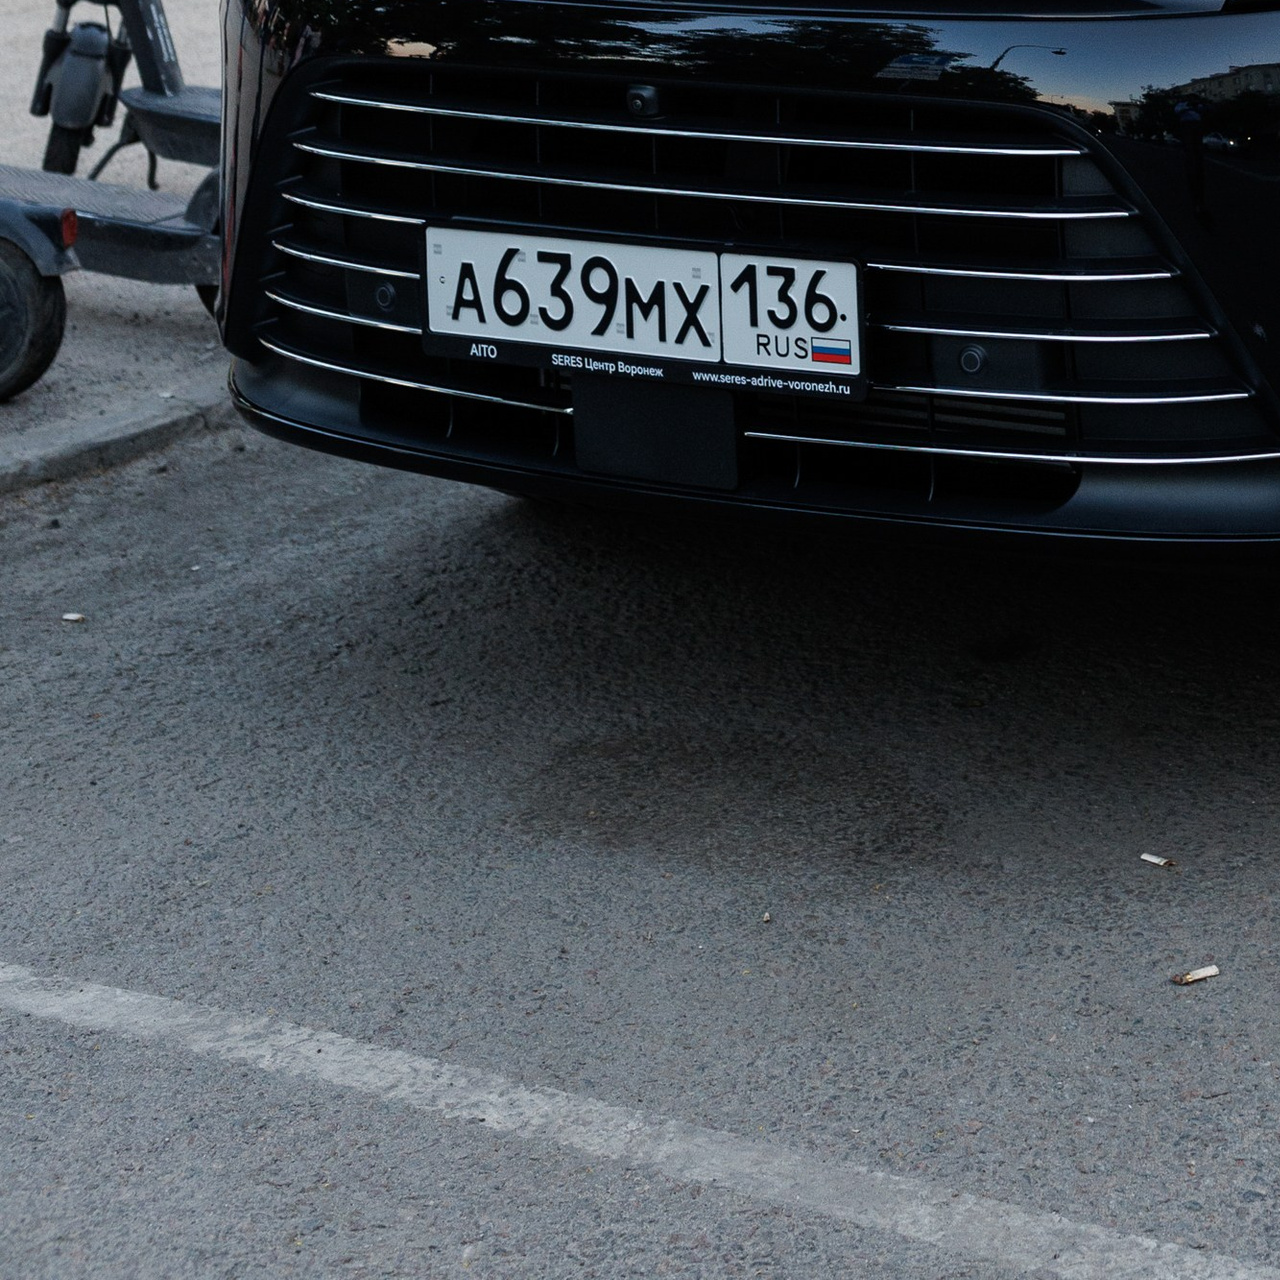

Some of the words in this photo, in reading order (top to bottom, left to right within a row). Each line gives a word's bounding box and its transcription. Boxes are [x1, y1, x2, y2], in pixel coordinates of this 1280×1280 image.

[451, 247, 712, 348] А639МХ
[730, 263, 839, 333] 136
[469, 343, 498, 359] AITO
[756, 333, 809, 360] RUS
[551, 353, 584, 368] SERES
[585, 356, 616, 374] Центр
[617, 361, 665, 378] Воронеж
[692, 370, 851, 395] www.seres-adrive-voronezh.ru
